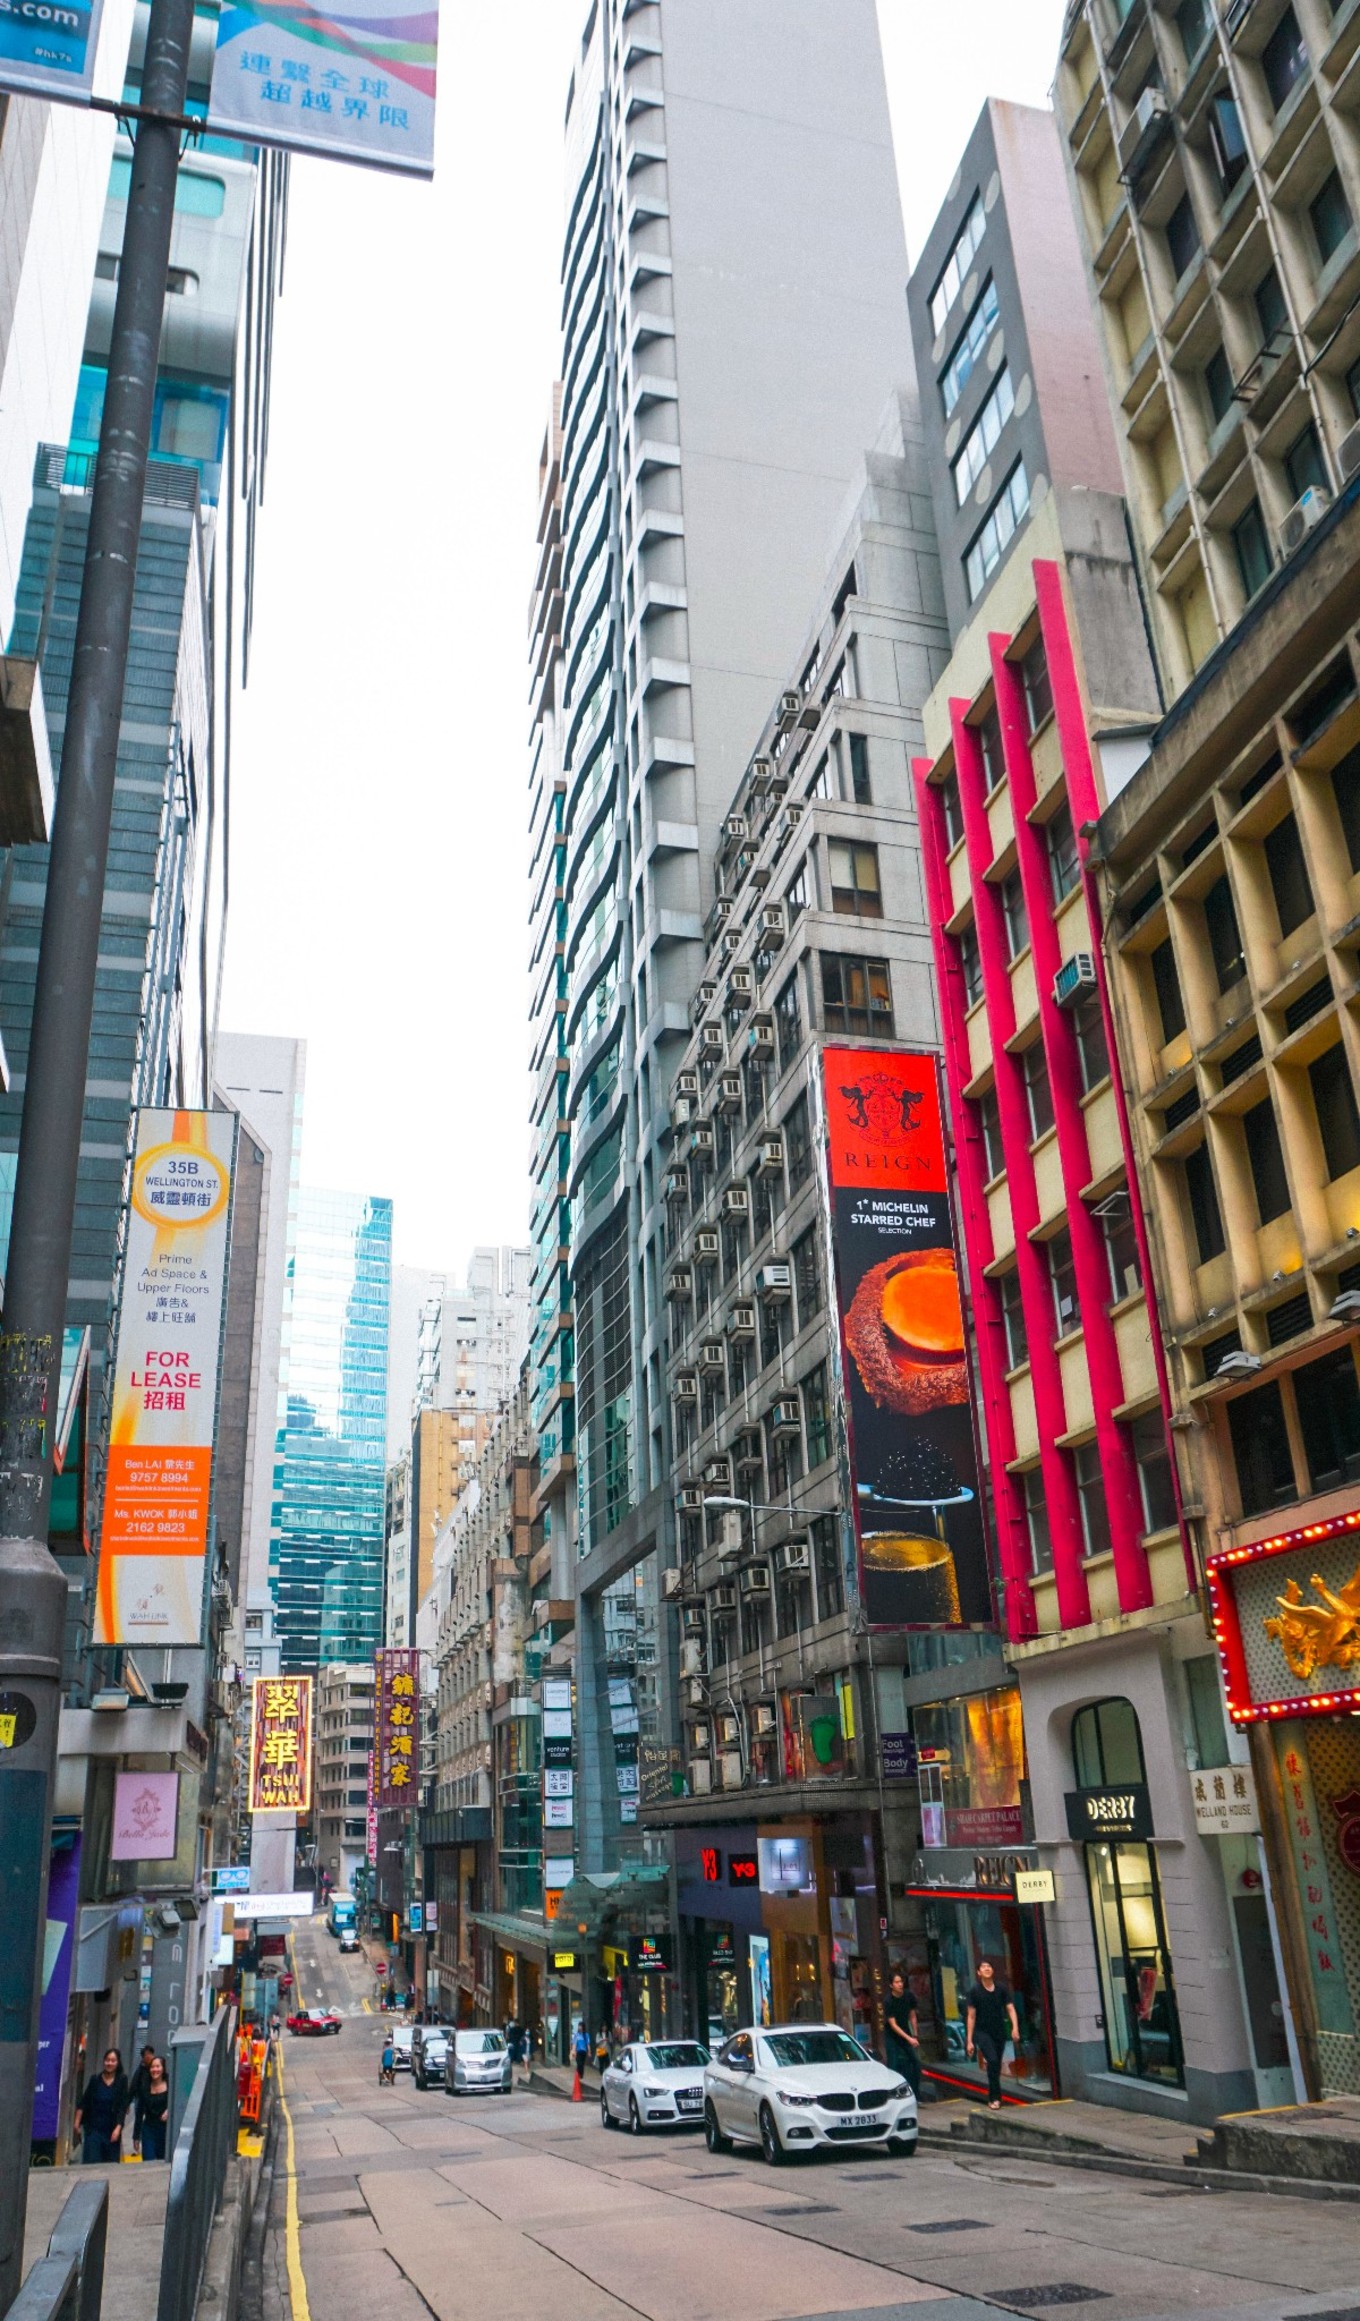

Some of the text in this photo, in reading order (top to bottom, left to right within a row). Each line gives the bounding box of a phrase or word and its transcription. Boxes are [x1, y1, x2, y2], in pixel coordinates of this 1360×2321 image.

[261, 80, 409, 130] 超越界限
[168, 1161, 199, 1175] 35B
[845, 1152, 931, 1171] REIGN
[145, 1176, 219, 1189] WELLINGTON ST.
[150, 1190, 212, 1207] 威靈頓街
[872, 1201, 929, 1214] MICHELIN
[851, 1213, 936, 1228] STARRED CHEF
[159, 1253, 193, 1264] Prime
[141, 1267, 208, 1280] Ad Space &
[137, 1281, 209, 1294] Upper Floors
[145, 1351, 190, 1368] FOR
[131, 1371, 202, 1389] LEASE
[143, 1390, 186, 1411] 招租
[125, 1459, 143, 1469] Ben
[129, 1471, 189, 1483] 9757 8994
[133, 1509, 164, 1519] KWOK
[126, 1521, 186, 1533] 2162 9823
[263, 1684, 300, 1771] 翠華
[389, 1672, 415, 1788] 鏞記酒家
[883, 1758, 909, 1769] Body
[262, 1774, 299, 1788] TSUI
[262, 1790, 299, 1804] WAH
[1087, 1795, 1136, 1820] DERBY
[1228, 1804, 1252, 1816] HOUSE
[1022, 1880, 1048, 1889] DERBY
[840, 2116, 853, 2126] MX
